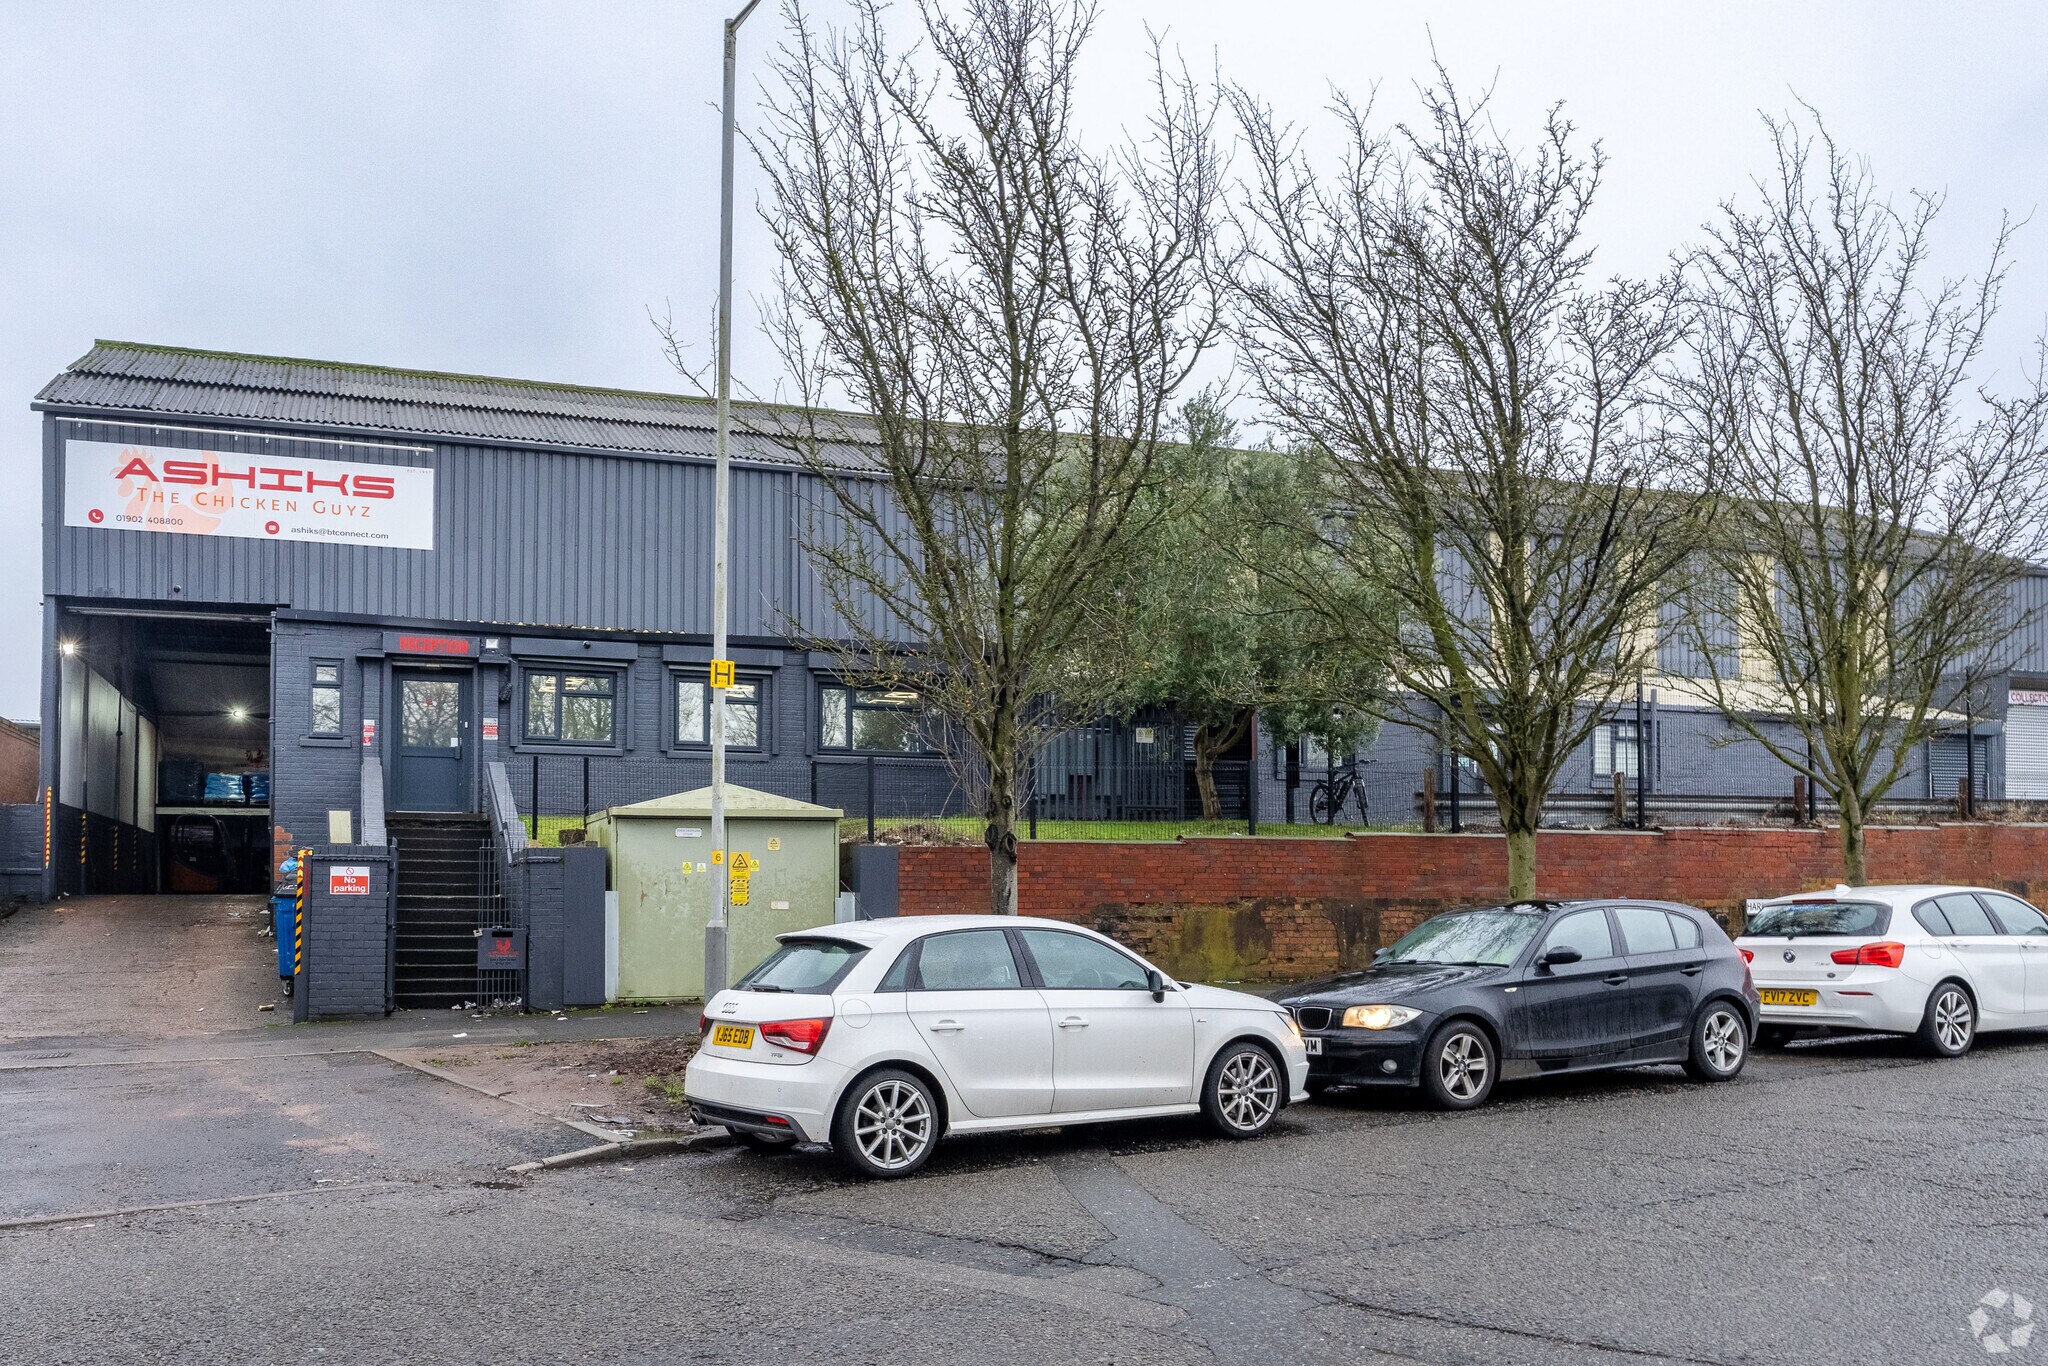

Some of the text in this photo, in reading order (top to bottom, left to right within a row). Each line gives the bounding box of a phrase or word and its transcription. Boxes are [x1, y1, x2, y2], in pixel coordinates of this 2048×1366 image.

[114, 457, 395, 500] ASHIKS
[137, 487, 371, 519] THE CHICKEN GUYZ
[115, 514, 184, 527] 01902 408800
[290, 526, 389, 540] ashiks@btconnect.com
[399, 635, 469, 656] RECEPTION
[714, 662, 732, 686] H
[715, 853, 722, 862] 6
[343, 876, 357, 884] No
[333, 884, 366, 894] parking
[1763, 991, 1810, 1004] FV17 ZVC
[715, 1026, 750, 1044] YJ65 EDB
